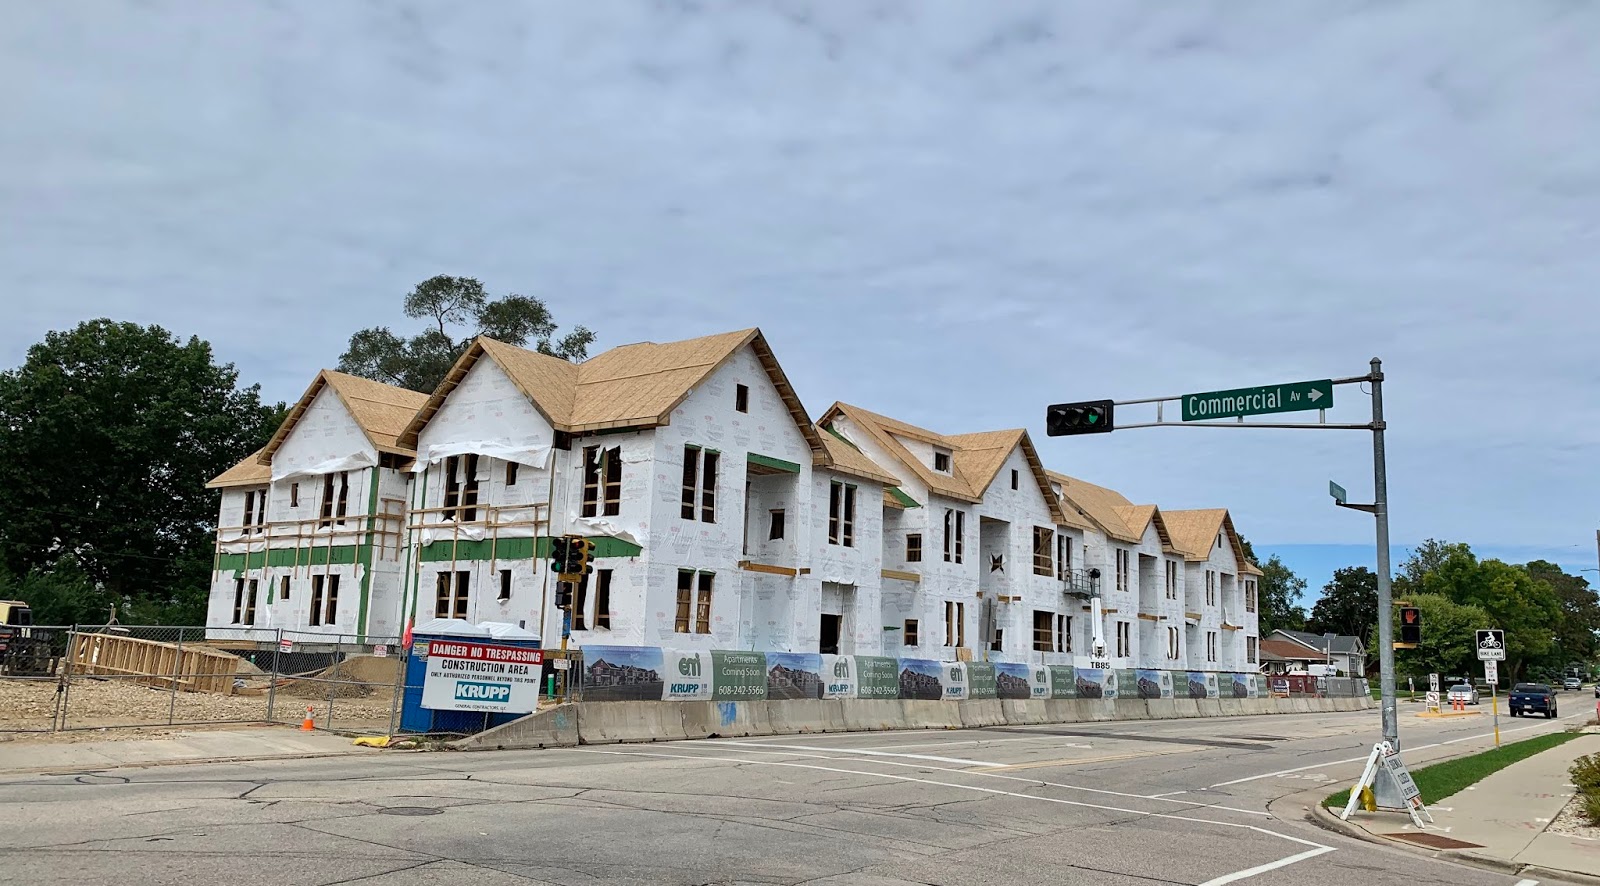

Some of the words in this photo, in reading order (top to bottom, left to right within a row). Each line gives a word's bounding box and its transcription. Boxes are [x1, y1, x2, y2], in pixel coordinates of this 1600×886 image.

[1189, 388, 1281, 416] Commercial
[1290, 391, 1300, 401] Av
[432, 643, 467, 656] DANGER
[471, 646, 482, 657] NO
[486, 648, 541, 663] TRESPASSING
[723, 655, 758, 664] Apartments
[442, 659, 505, 673] CONSTRUCTION
[508, 664, 529, 675] AREA
[1090, 661, 1111, 670] TB85
[443, 672, 470, 680] AUTHORIZED
[471, 674, 496, 682] PERSONNEL
[722, 668, 744, 678] Coming
[746, 668, 760, 676] Soon
[863, 671, 881, 680] Coming
[456, 684, 510, 699] KRUPP
[670, 683, 699, 693] KRUPP
[718, 685, 764, 695] 608-242-5566
[828, 684, 848, 692] KRUPP
